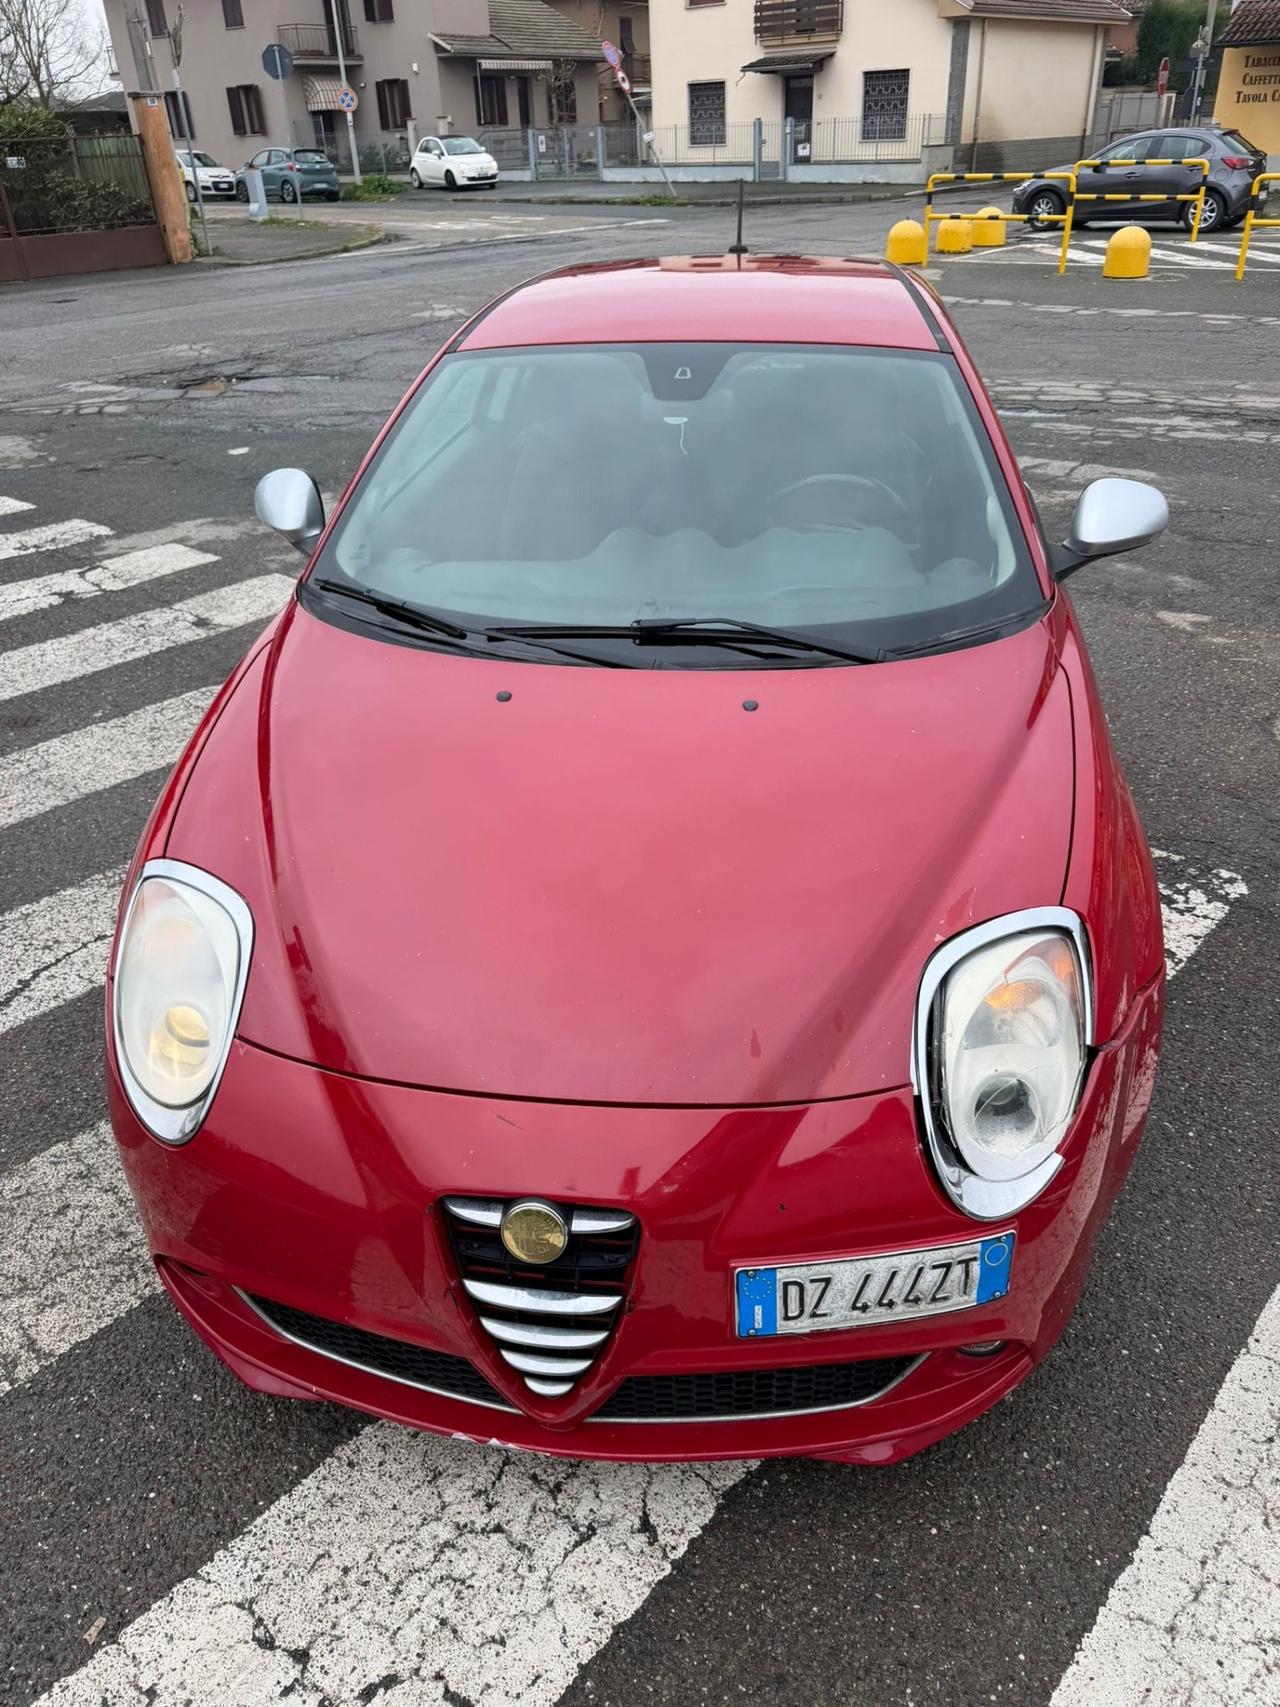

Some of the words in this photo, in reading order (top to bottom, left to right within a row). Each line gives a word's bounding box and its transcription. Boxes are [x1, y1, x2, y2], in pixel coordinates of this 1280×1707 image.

[1242, 73, 1280, 86] CAFFETT
[1235, 91, 1267, 104] TAVOLA
[782, 1277, 832, 1321] DZ
[851, 1256, 978, 1313] 444ZT
